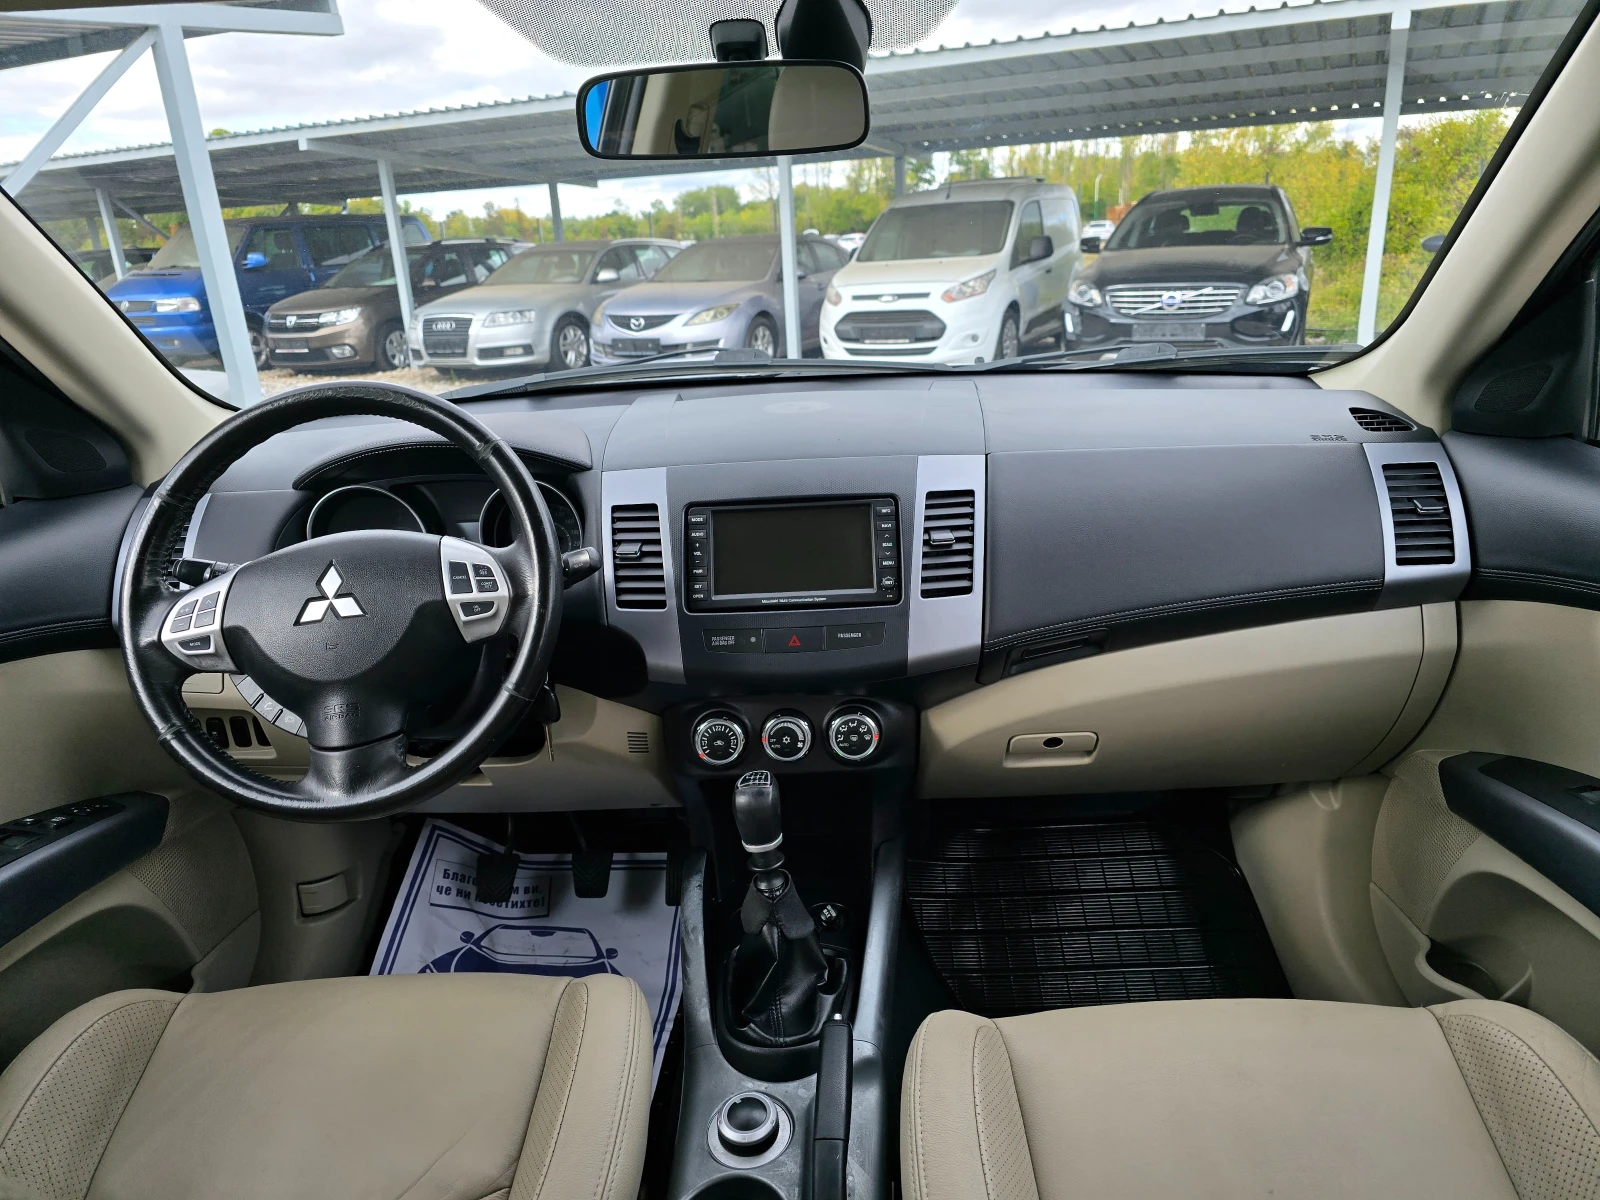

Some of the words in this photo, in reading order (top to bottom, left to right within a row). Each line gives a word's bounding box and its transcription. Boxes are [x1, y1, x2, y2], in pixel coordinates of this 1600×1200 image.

[436, 884, 452, 896] че
[455, 888, 471, 900] ни
[442, 868, 519, 895] Благом
[523, 885, 542, 895] ви,
